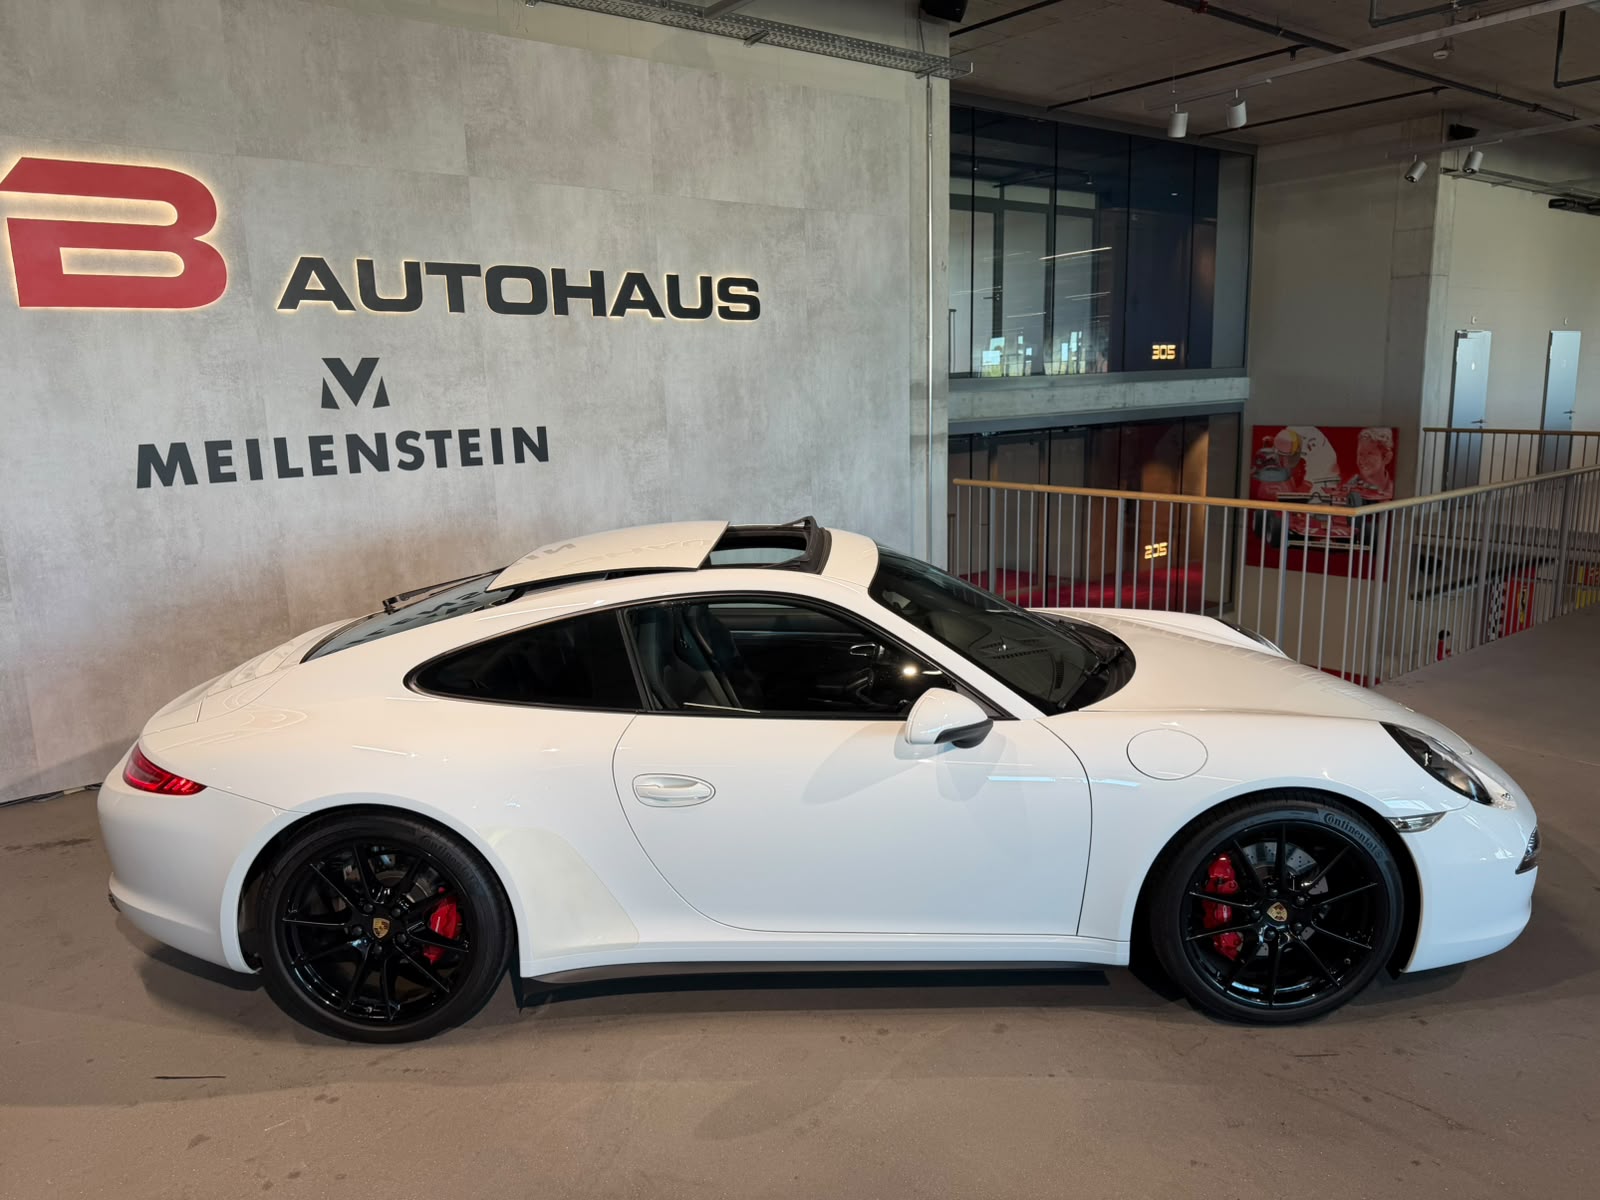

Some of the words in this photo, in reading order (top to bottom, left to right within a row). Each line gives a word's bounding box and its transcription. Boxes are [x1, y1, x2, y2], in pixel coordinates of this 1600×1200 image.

[277, 256, 760, 321] AUTOHAUS
[1152, 344, 1176, 360] 305
[136, 425, 549, 489] MEILENSTEIN
[1144, 541, 1168, 560] 205
[1323, 812, 1378, 852] Continental
